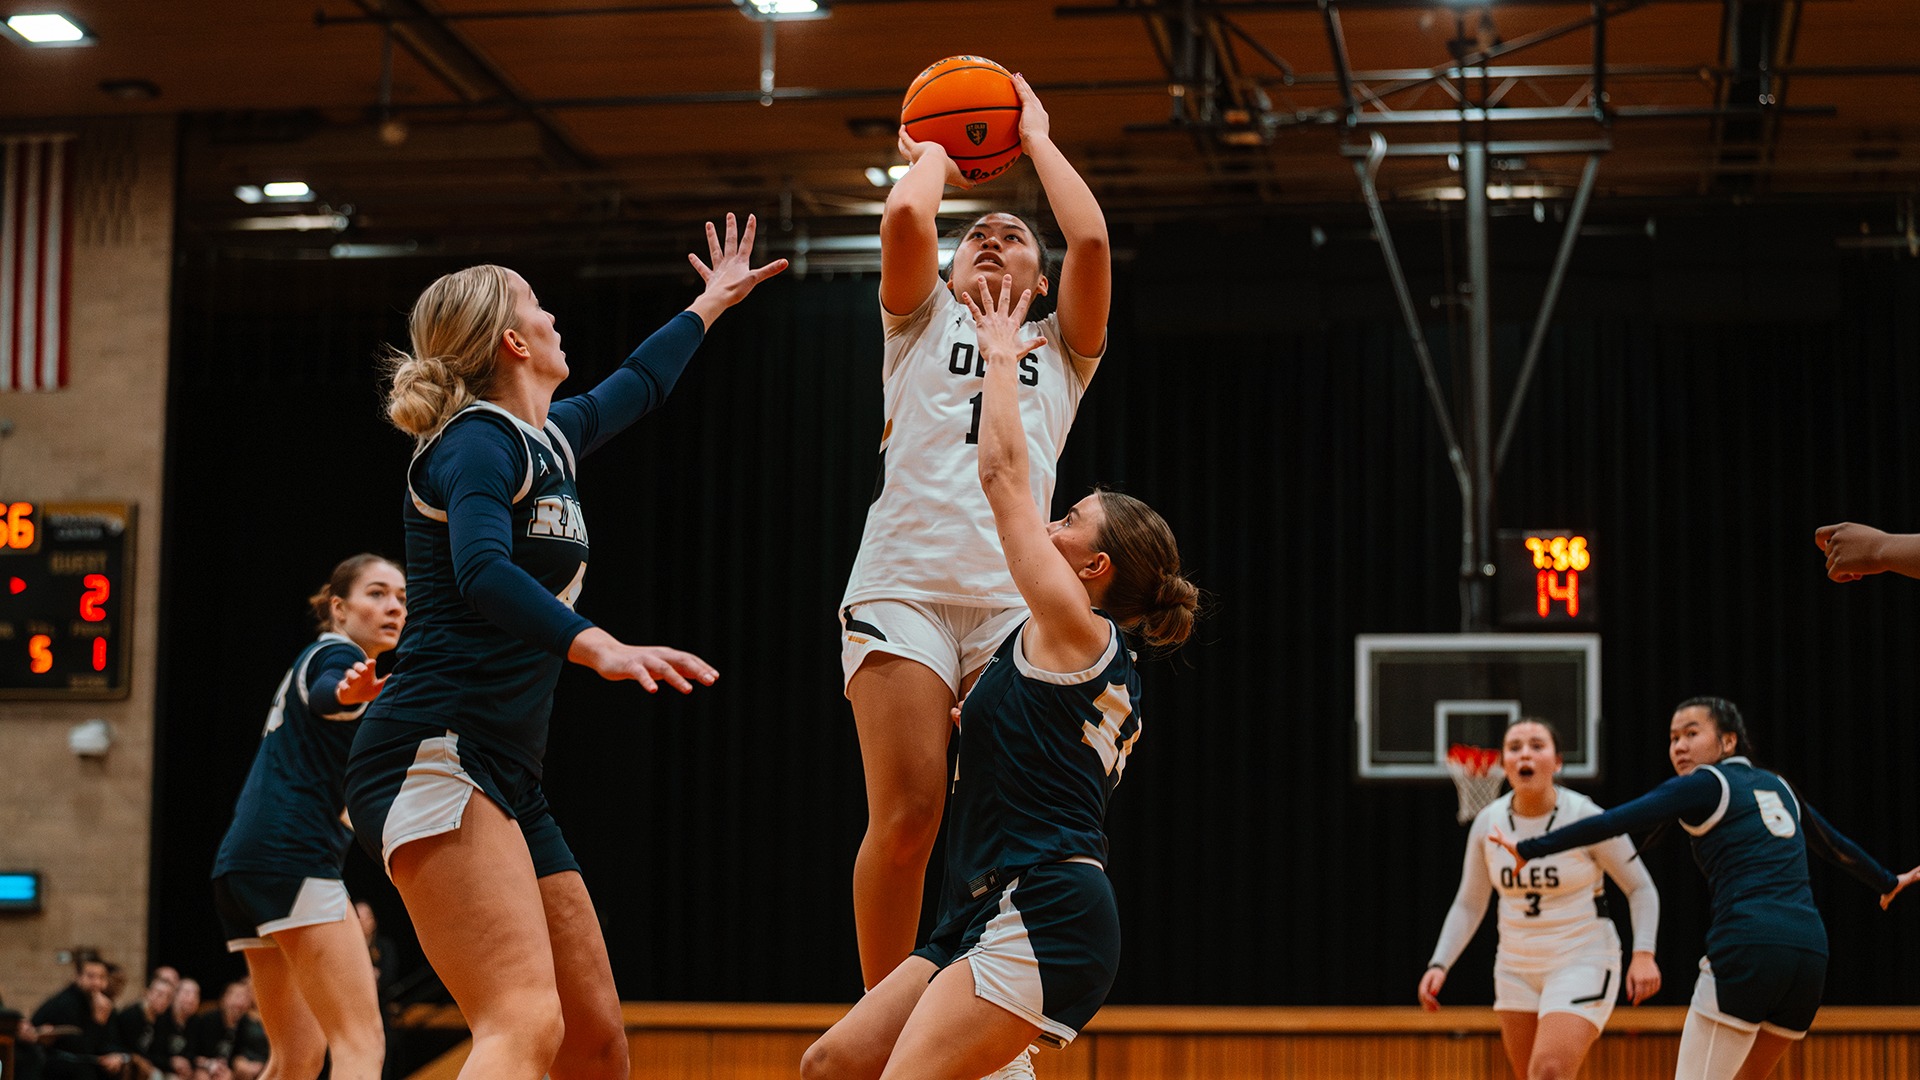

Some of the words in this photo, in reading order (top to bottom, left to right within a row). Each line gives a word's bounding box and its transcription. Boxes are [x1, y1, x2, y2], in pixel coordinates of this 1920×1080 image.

[949, 342, 1039, 387] OLS
[1525, 536, 1591, 572] 7:56
[79, 573, 111, 622] 2
[1537, 569, 1579, 618] 14
[28, 633, 53, 674] 5
[92, 636, 107, 672] 1
[1500, 866, 1560, 889] OLES
[1523, 892, 1542, 918] 3
